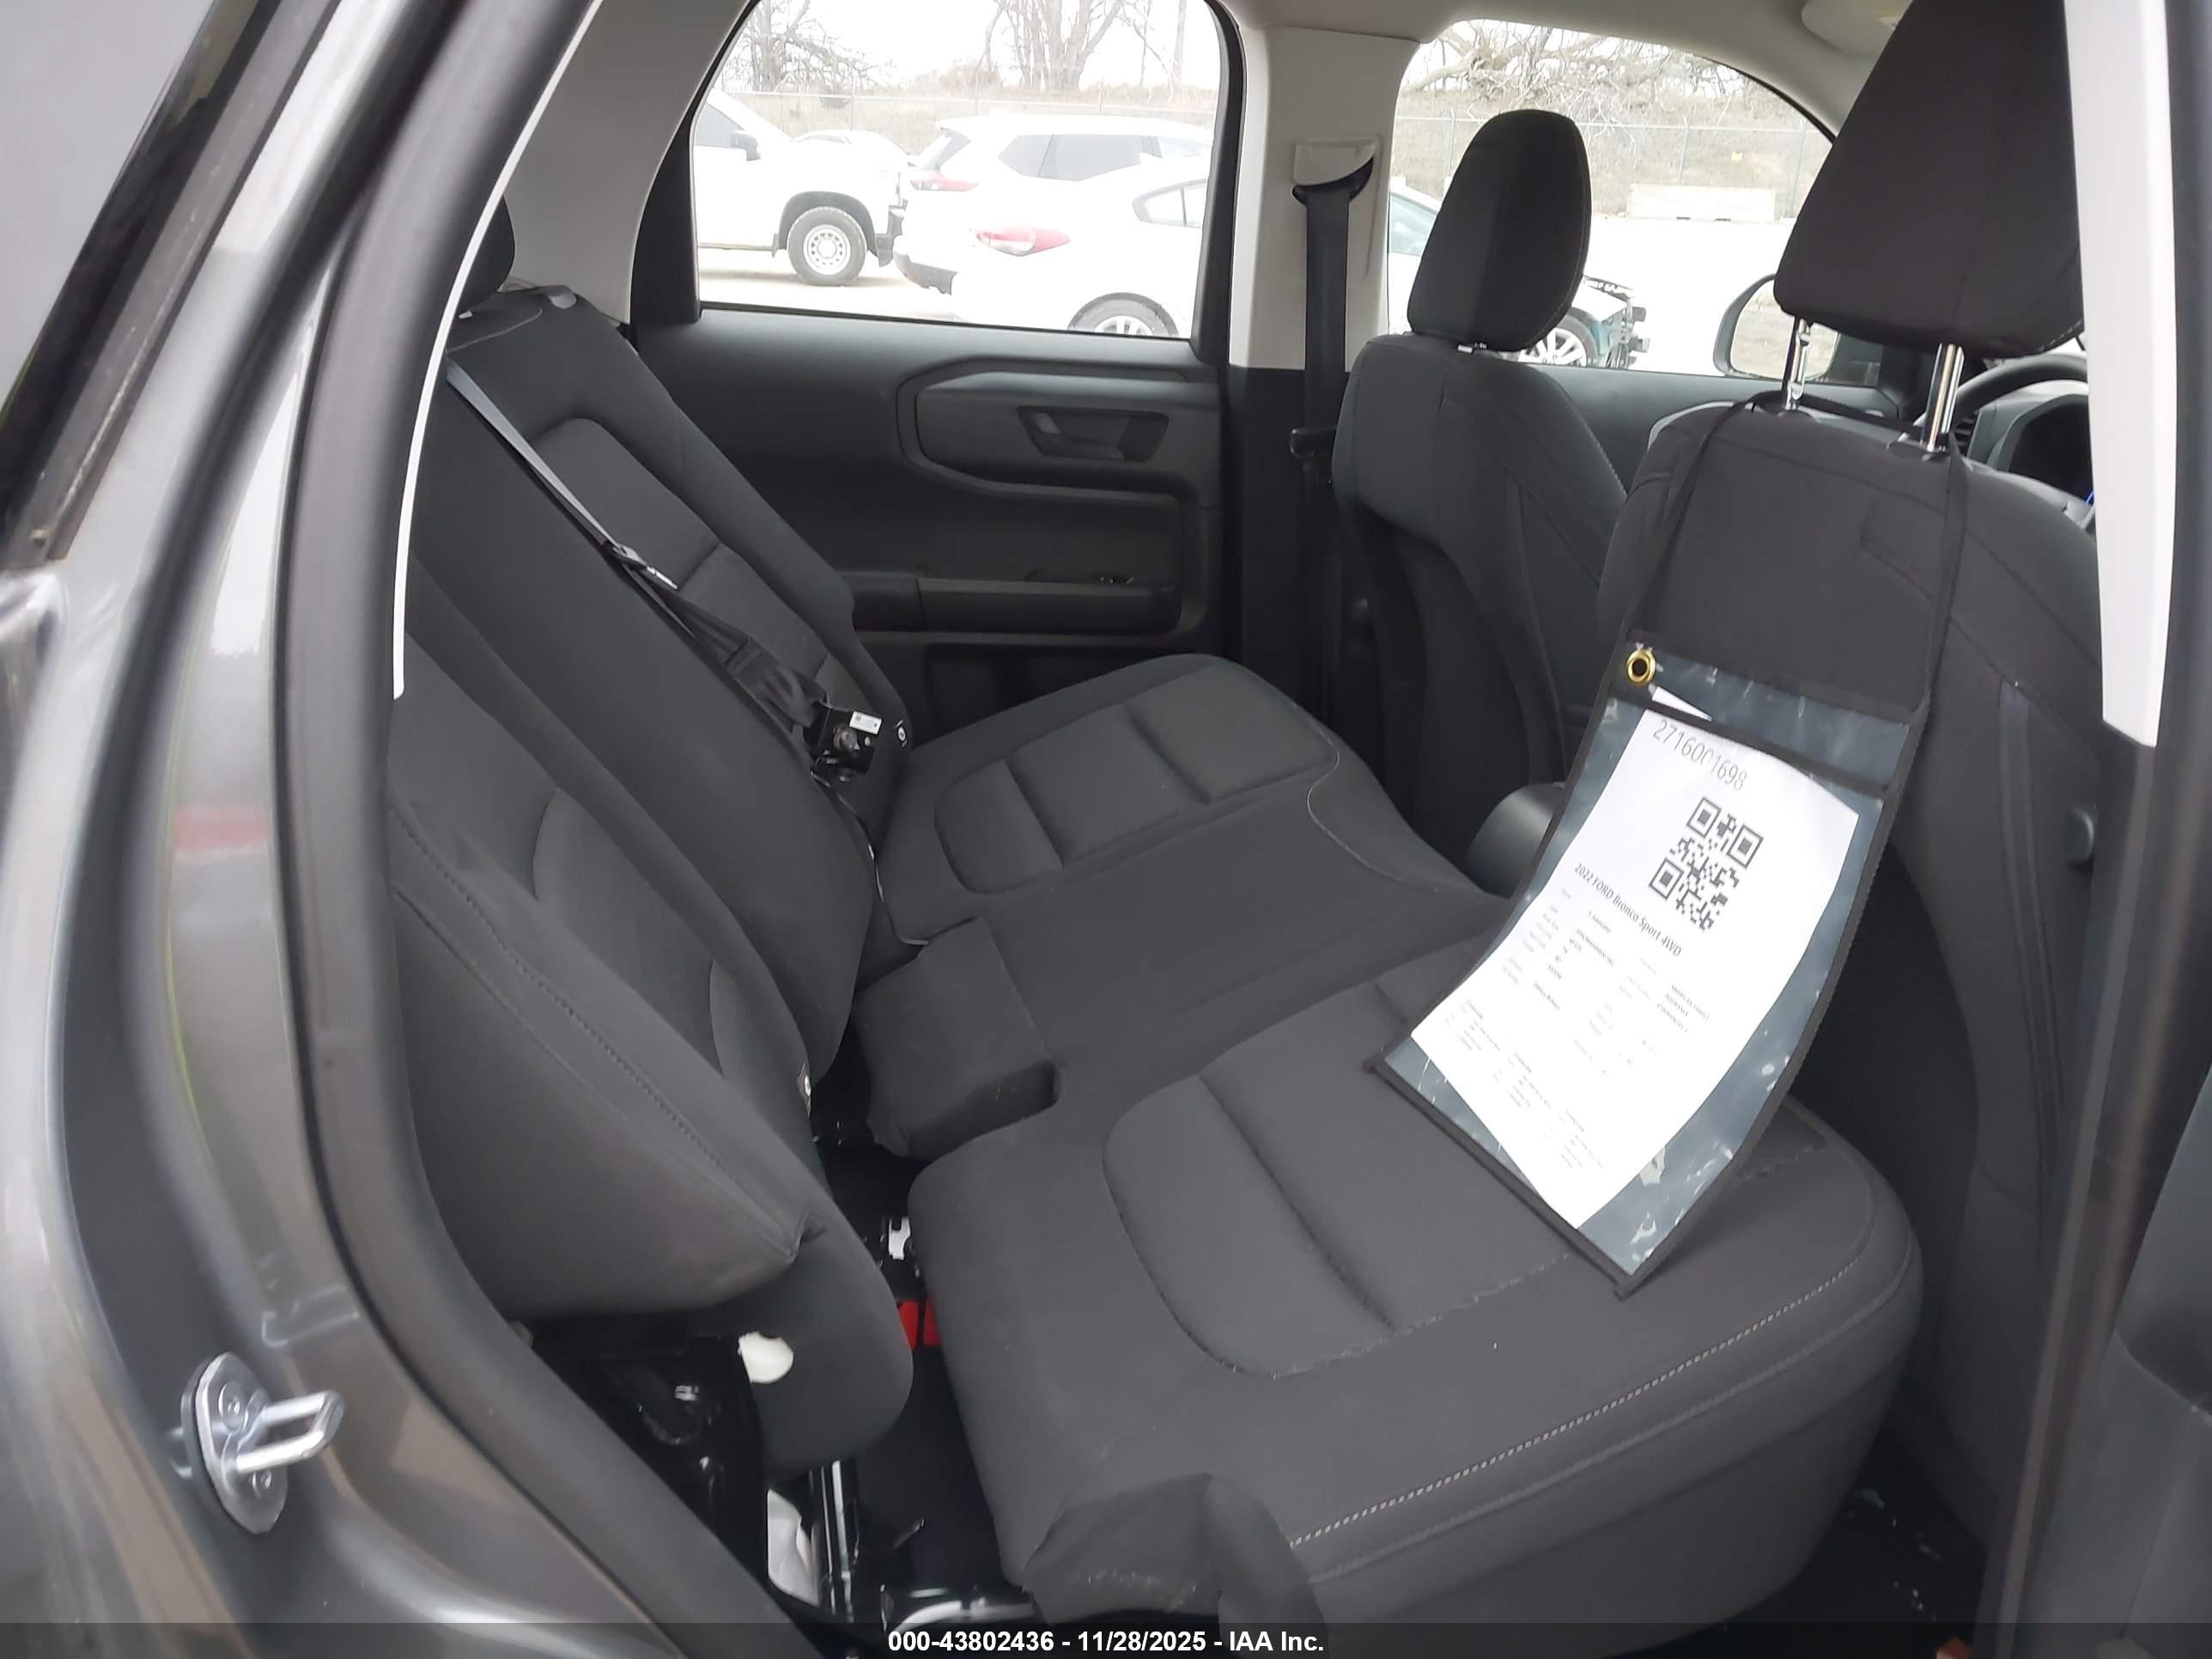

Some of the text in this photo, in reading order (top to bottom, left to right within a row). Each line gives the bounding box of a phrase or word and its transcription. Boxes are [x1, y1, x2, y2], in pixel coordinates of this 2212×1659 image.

[1652, 718, 1747, 791] 2716001698
[1574, 862, 1594, 884] 2022
[1592, 876, 1614, 900] FORD
[1613, 893, 1639, 922] Bronco
[1638, 915, 1662, 941] Sport
[1661, 935, 1681, 957] 4WD
